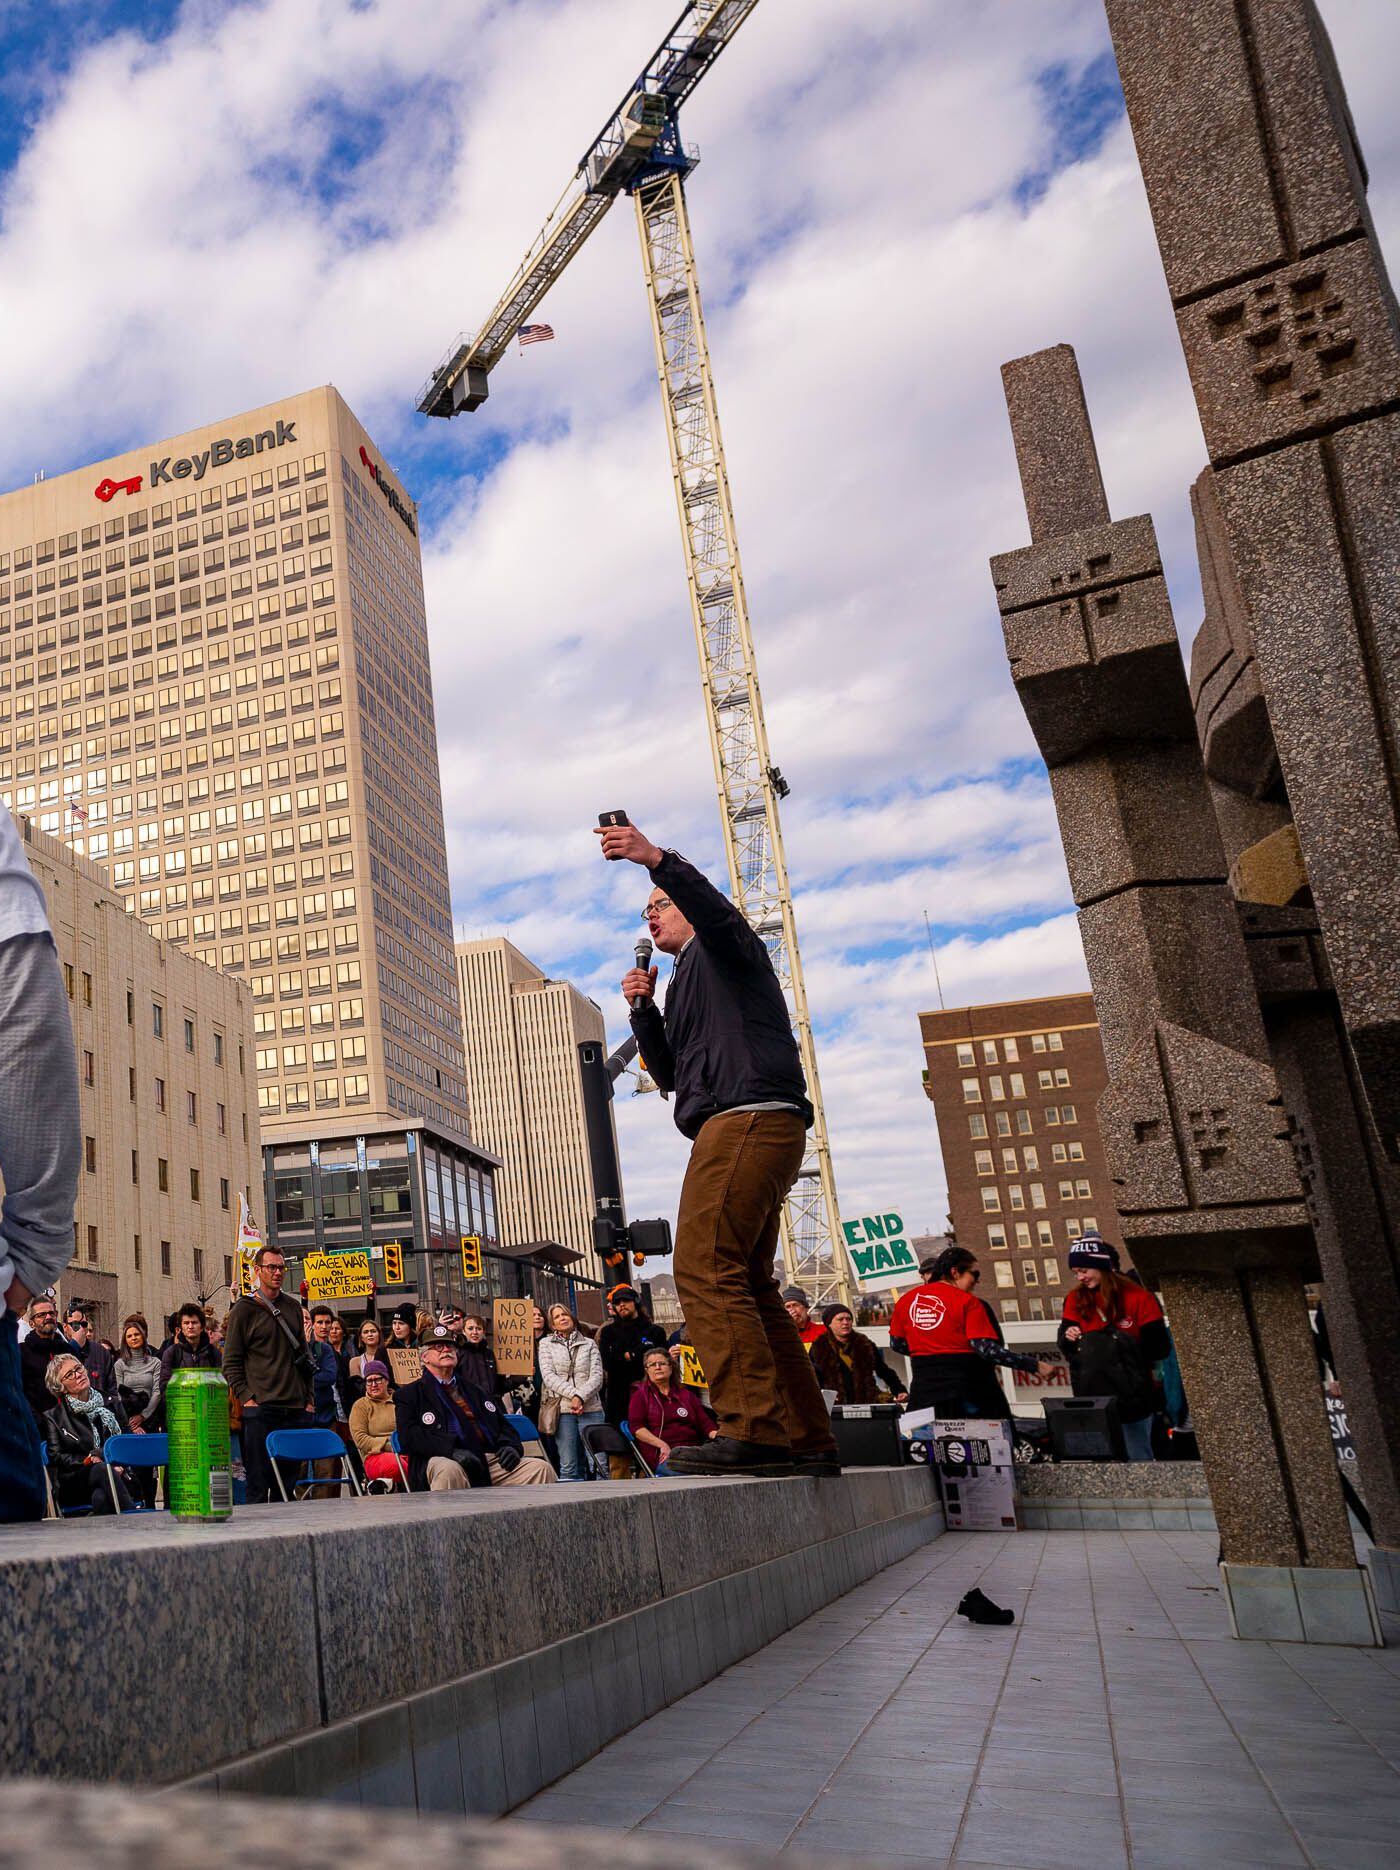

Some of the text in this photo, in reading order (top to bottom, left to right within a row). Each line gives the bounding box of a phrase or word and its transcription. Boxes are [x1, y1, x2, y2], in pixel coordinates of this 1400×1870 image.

[150, 419, 298, 488] KeyBank
[841, 1213, 904, 1246] END
[305, 1254, 368, 1270] WAGE WAR
[849, 1238, 915, 1275] WAR
[311, 1275, 351, 1287] CLIMATE
[318, 1286, 339, 1296] NOT
[500, 1302, 527, 1317] NO
[497, 1319, 528, 1330] WAR
[497, 1335, 532, 1346] WITH
[395, 1350, 407, 1359] NO
[497, 1347, 532, 1361] IRAN
[397, 1359, 417, 1367] WITH
[407, 1368, 422, 1379] IR
